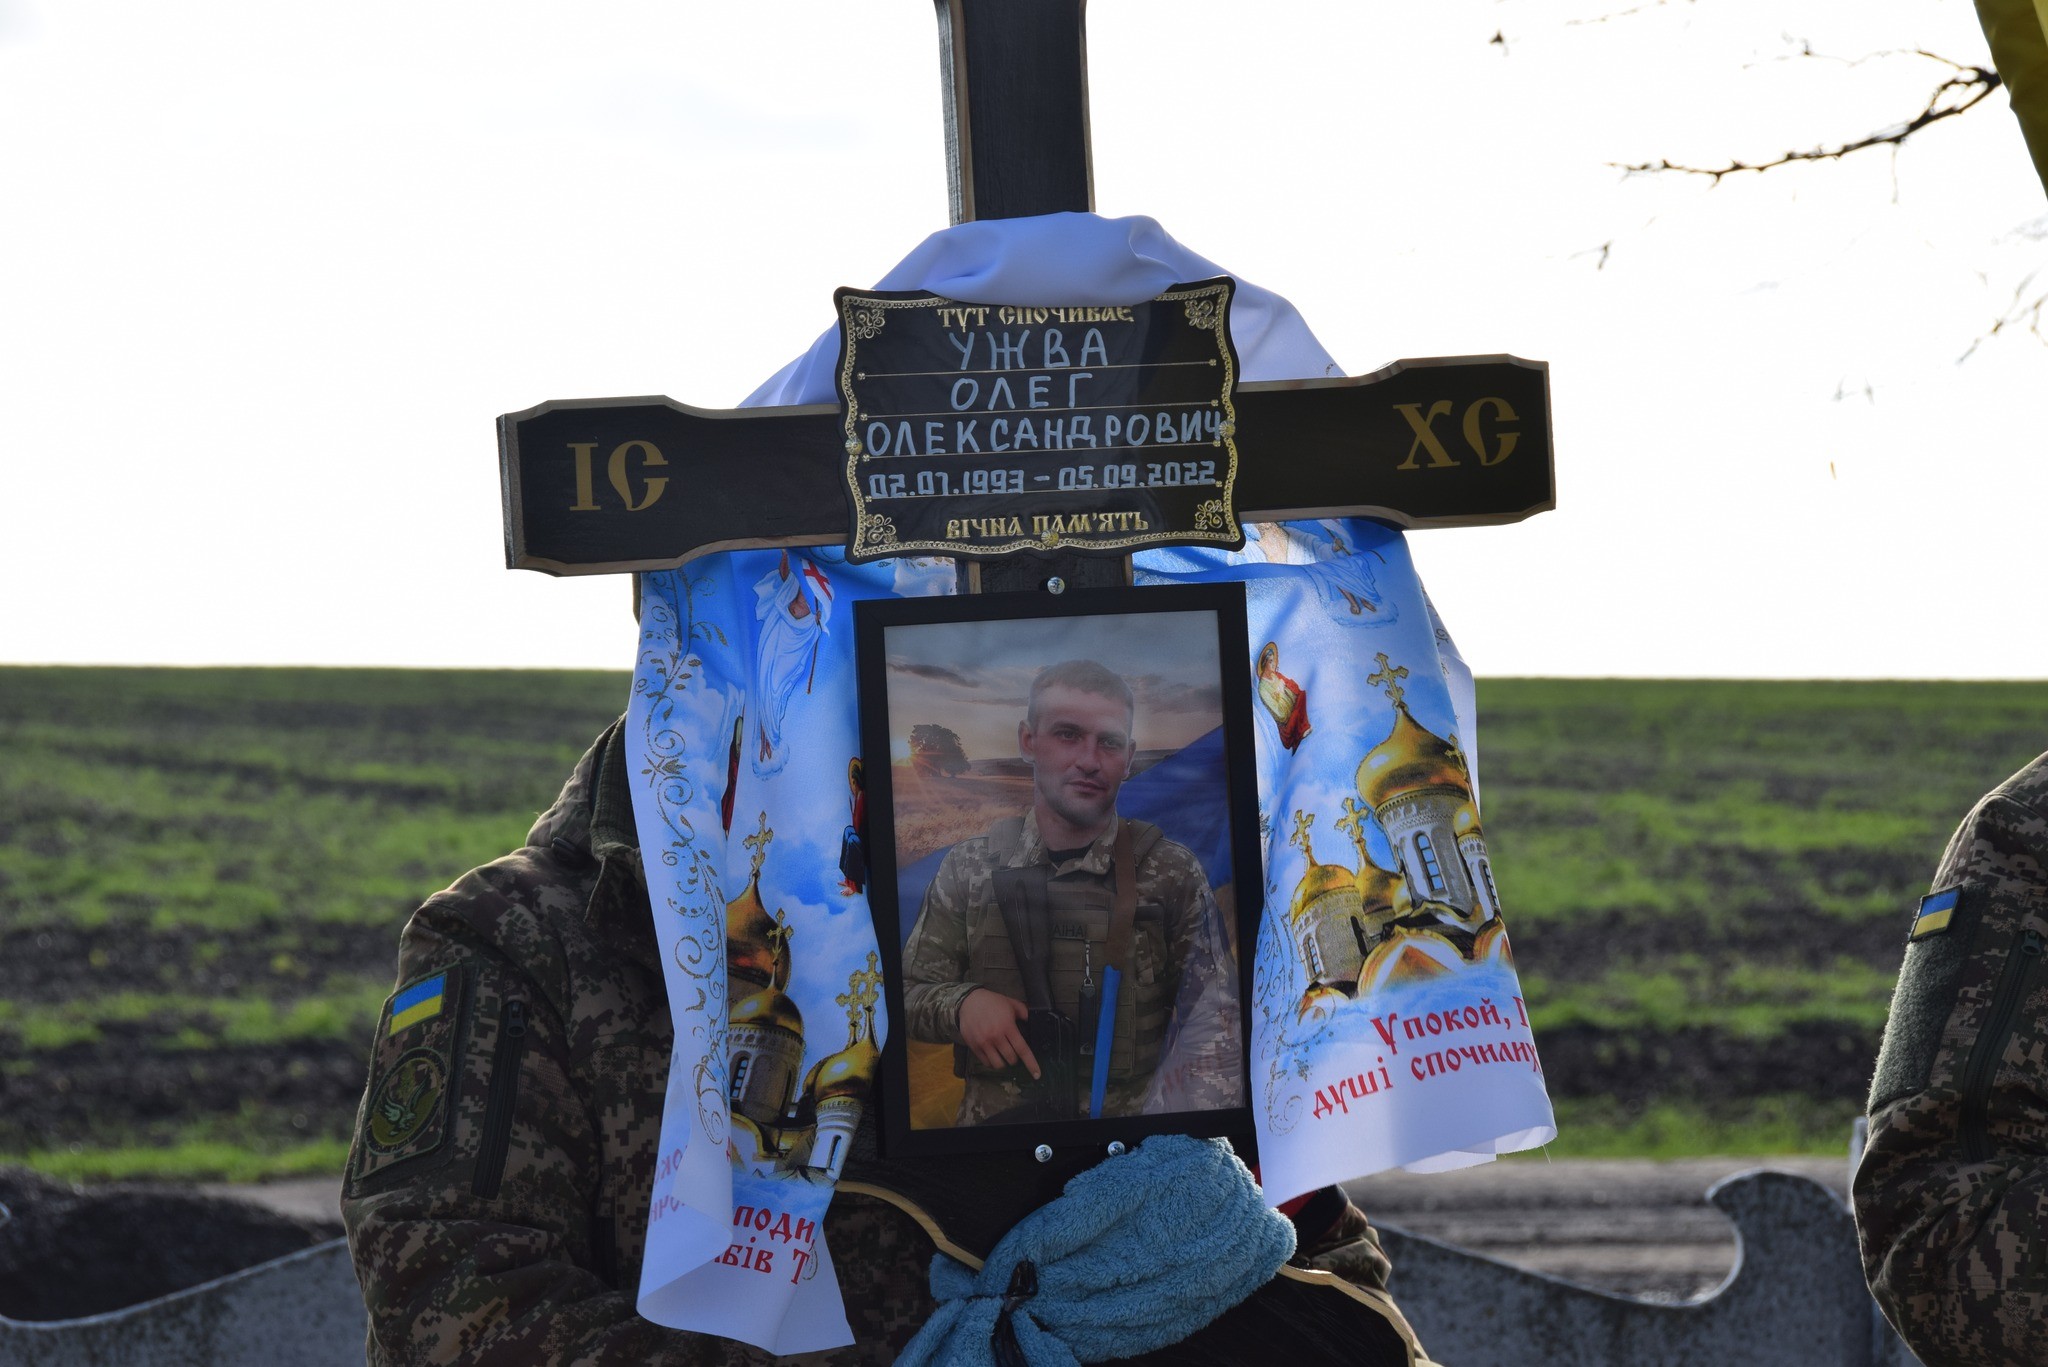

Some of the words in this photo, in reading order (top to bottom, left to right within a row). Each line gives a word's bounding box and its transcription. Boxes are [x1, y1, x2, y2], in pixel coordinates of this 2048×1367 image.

[937, 307, 990, 333] ТУТ
[949, 327, 1109, 371] УЖВА
[950, 371, 1093, 411] ОЛЕГ
[866, 410, 1221, 457] ОЛЕКСАНДРОВИЧ
[1057, 460, 1216, 491] 05.09.2022
[946, 516, 1025, 539] ВІЧНА
[1369, 997, 1512, 1056] Упокой,
[1312, 1056, 1394, 1120] душі
[732, 1205, 816, 1252] поди,
[713, 1236, 774, 1274] бів
